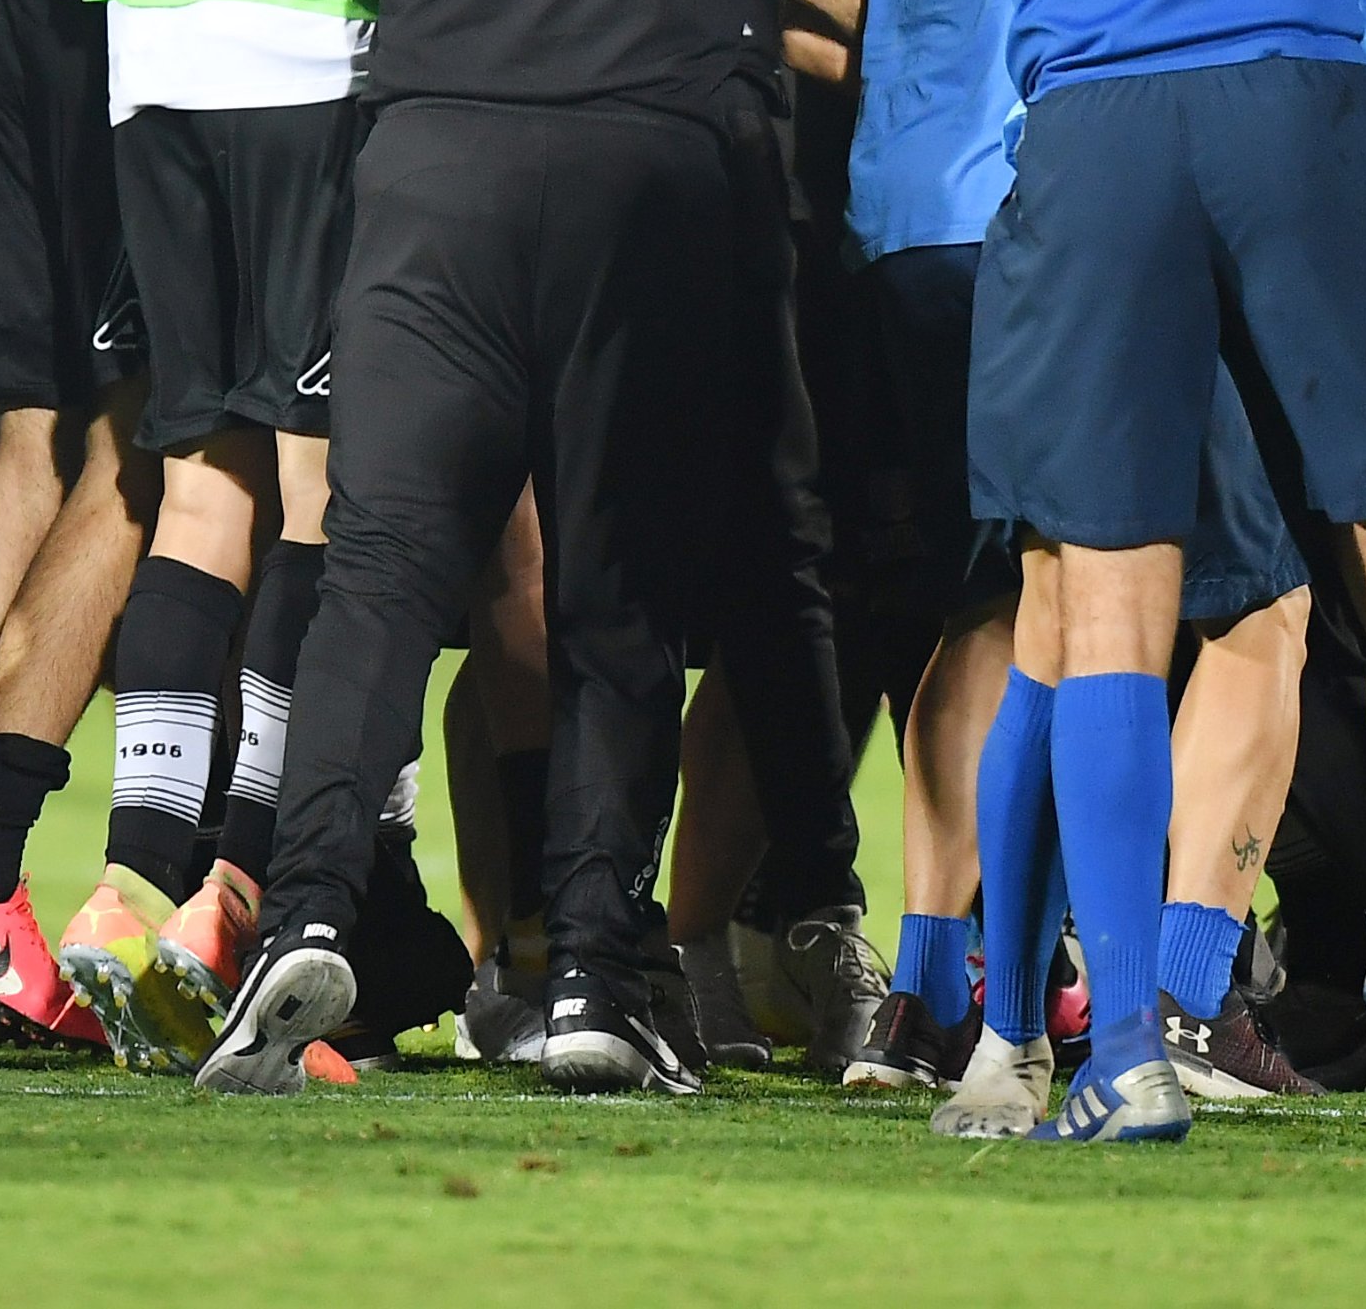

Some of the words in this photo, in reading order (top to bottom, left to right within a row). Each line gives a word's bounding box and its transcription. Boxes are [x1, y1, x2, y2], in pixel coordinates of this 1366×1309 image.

[120, 742, 182, 759] 1906
[302, 923, 338, 941] NIKE
[552, 998, 588, 1021] NIKE
